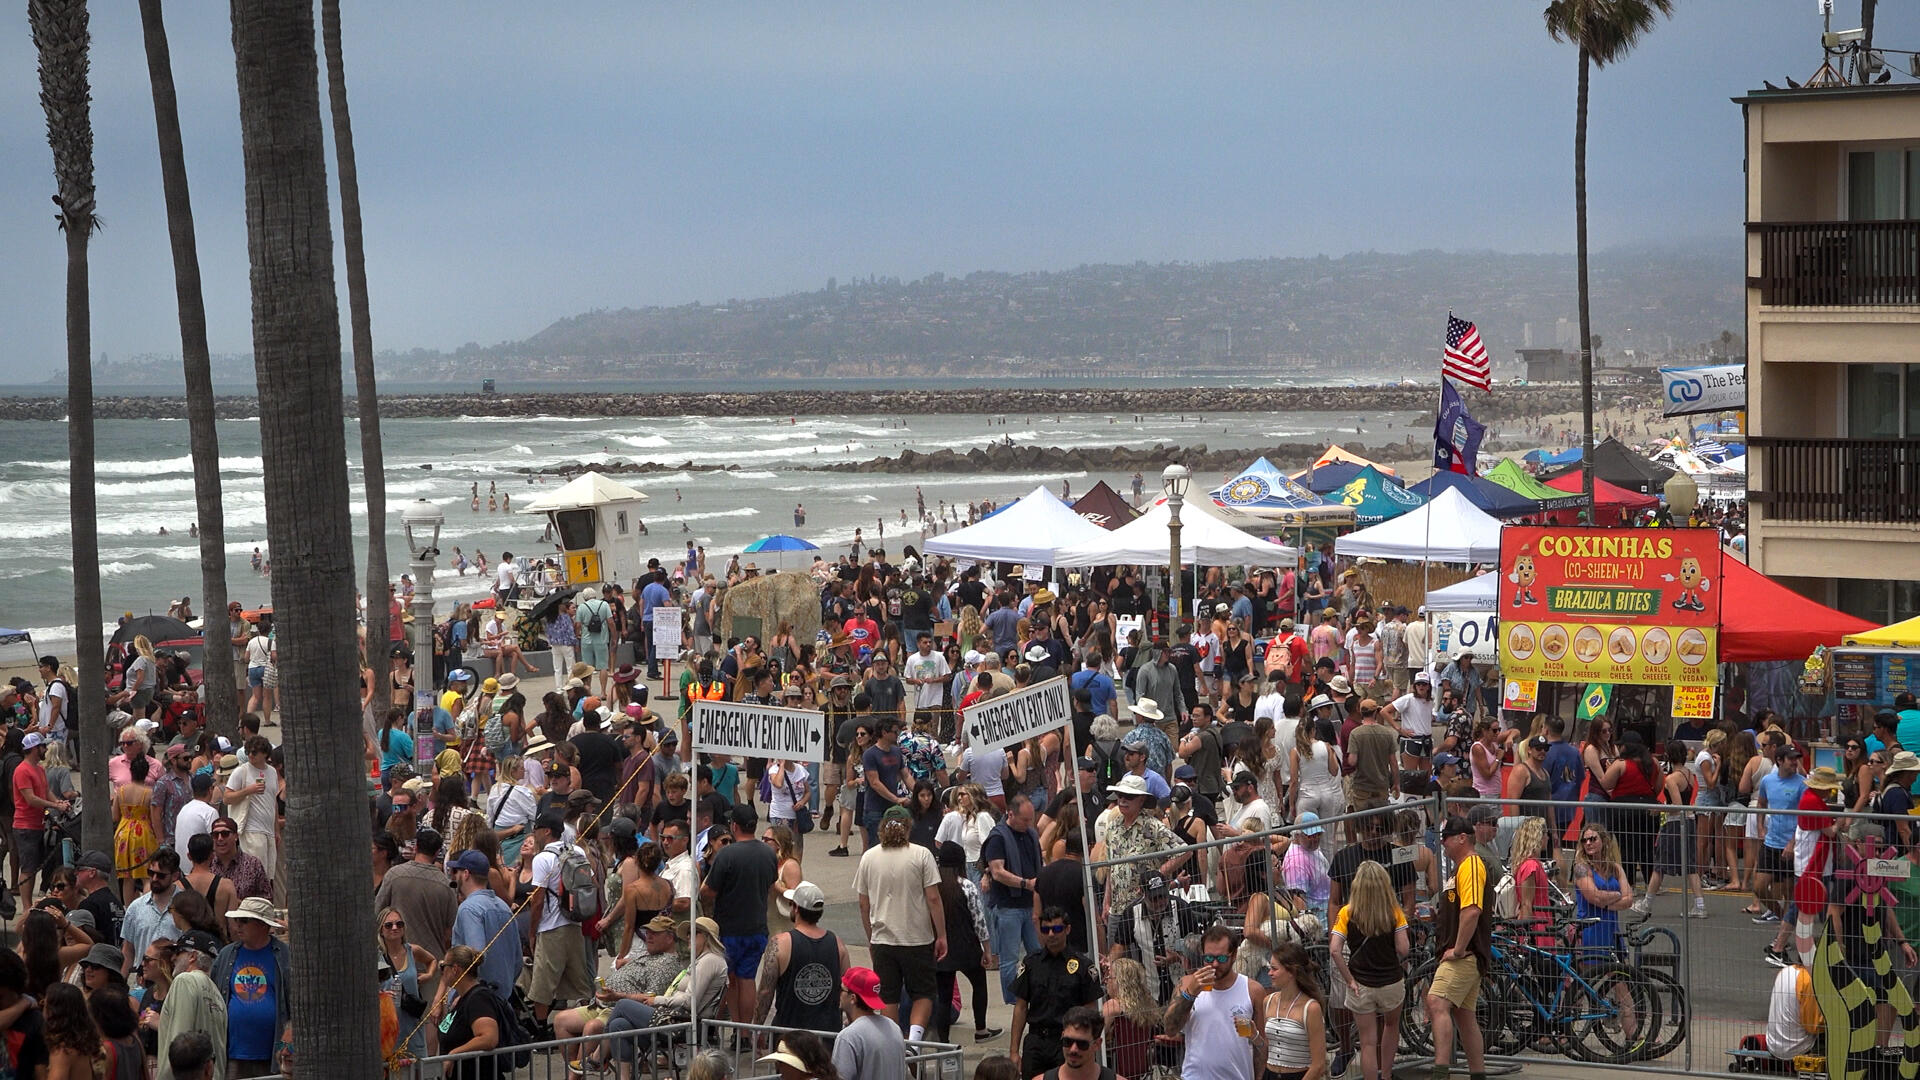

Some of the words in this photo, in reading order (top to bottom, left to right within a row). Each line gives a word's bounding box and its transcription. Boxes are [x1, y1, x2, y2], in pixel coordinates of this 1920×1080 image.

[1704, 374, 1726, 388] The
[1708, 393, 1726, 403] YOUR
[1538, 536, 1672, 558] COXINHAS
[1564, 560, 1644, 580] (CO-SHEEN-YA)
[1554, 590, 1611, 610] BRAZUCA
[1616, 590, 1652, 612] BITES
[1511, 666, 1535, 674] CHICKEN
[1544, 662, 1564, 670] BACON
[1644, 665, 1668, 673] GARLIC
[1610, 672, 1633, 680] CHEESE
[1679, 674, 1708, 682] (VEGAN)
[978, 698, 1029, 746] EMERGENCY
[1027, 692, 1046, 728] EXIT
[1044, 685, 1066, 722] ONLY
[699, 709, 760, 748] EMERGENCY
[762, 715, 782, 750] EXIT
[785, 717, 809, 753] ONLY
